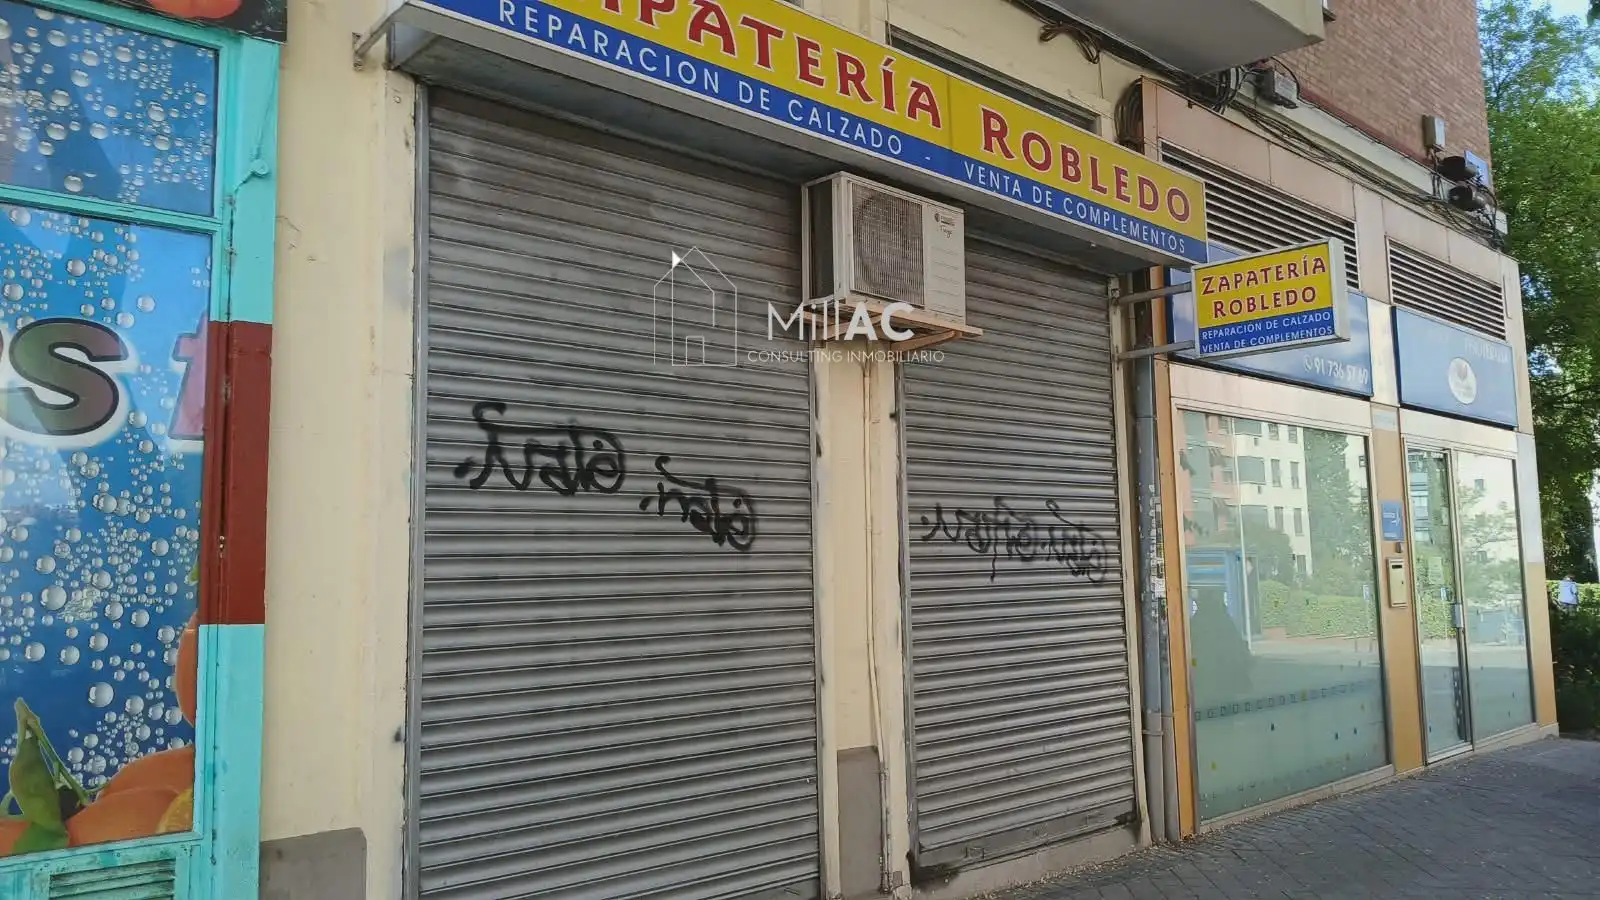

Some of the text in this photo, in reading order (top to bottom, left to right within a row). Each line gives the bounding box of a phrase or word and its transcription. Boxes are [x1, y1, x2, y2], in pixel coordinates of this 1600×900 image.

[499, 1, 719, 94] REPARACION
[738, 80, 770, 111] DE
[788, 99, 902, 155] CALZADO
[963, 160, 1022, 198] VENTA
[1032, 186, 1053, 209] DE
[1063, 197, 1185, 254] COMPLEMENTOS
[602, 0, 1191, 223] PATERÍA ROBLEDO
[1202, 255, 1326, 295] ZAPATERÍA
[1213, 286, 1316, 318] ROBLEDO
[1265, 319, 1279, 330] DE
[1282, 311, 1331, 327] CALZADO
[1202, 326, 1333, 353] VENTA DE COMPLEMENTOS
